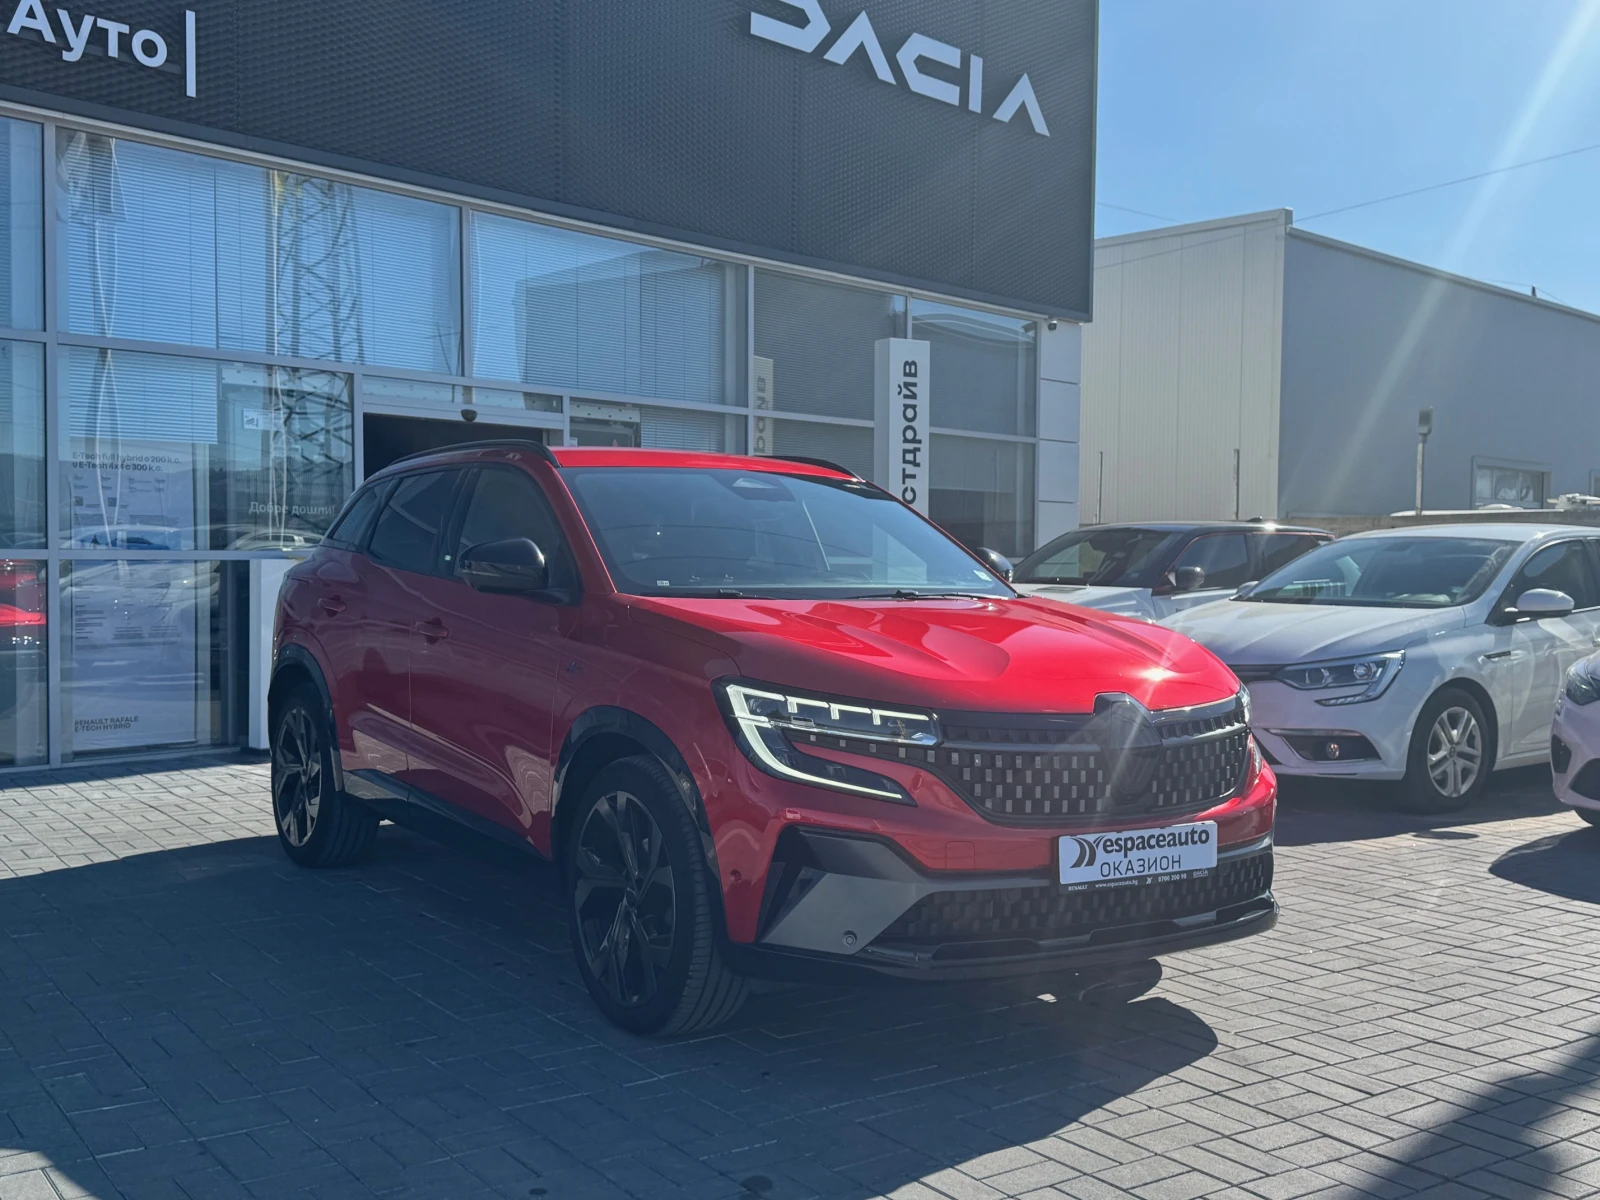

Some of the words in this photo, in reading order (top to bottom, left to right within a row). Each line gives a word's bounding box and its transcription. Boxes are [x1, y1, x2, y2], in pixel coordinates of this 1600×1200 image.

[151, 455, 167, 464] 200
[132, 462, 148, 471] 300
[248, 501, 288, 516] Добре
[74, 718, 108, 726] RENAULT
[110, 715, 139, 723] RAFALE
[103, 723, 131, 731] HYBRID
[1102, 826, 1210, 858] espaceauto
[1100, 854, 1182, 878] ОКАЗИОН
